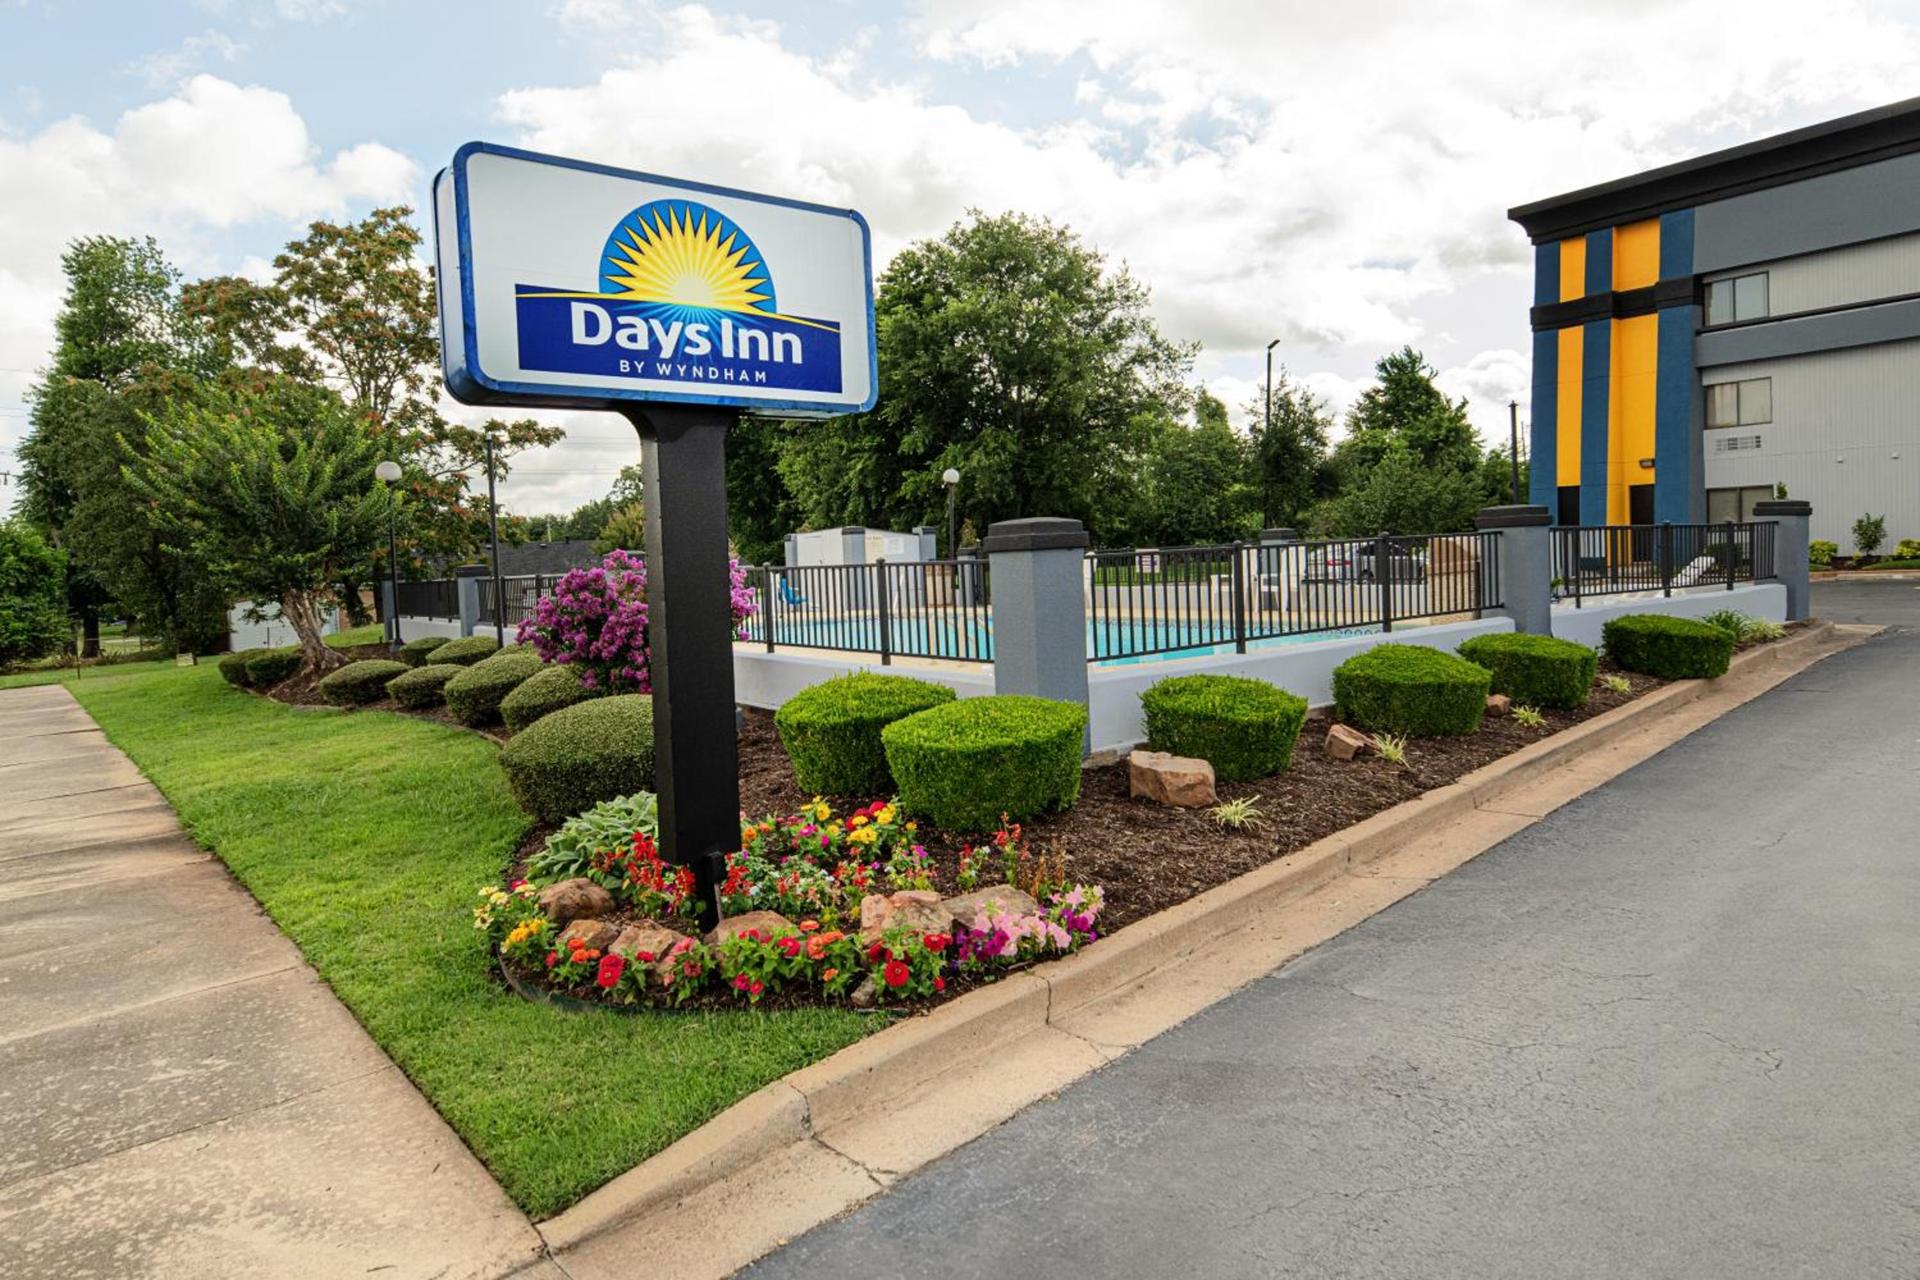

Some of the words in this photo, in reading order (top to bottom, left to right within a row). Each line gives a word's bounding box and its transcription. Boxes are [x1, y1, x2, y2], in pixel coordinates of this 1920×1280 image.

[570, 301, 711, 359] Days
[721, 319, 803, 364] Inn
[619, 359, 645, 374] BY
[656, 362, 767, 383] WYNDHAM
